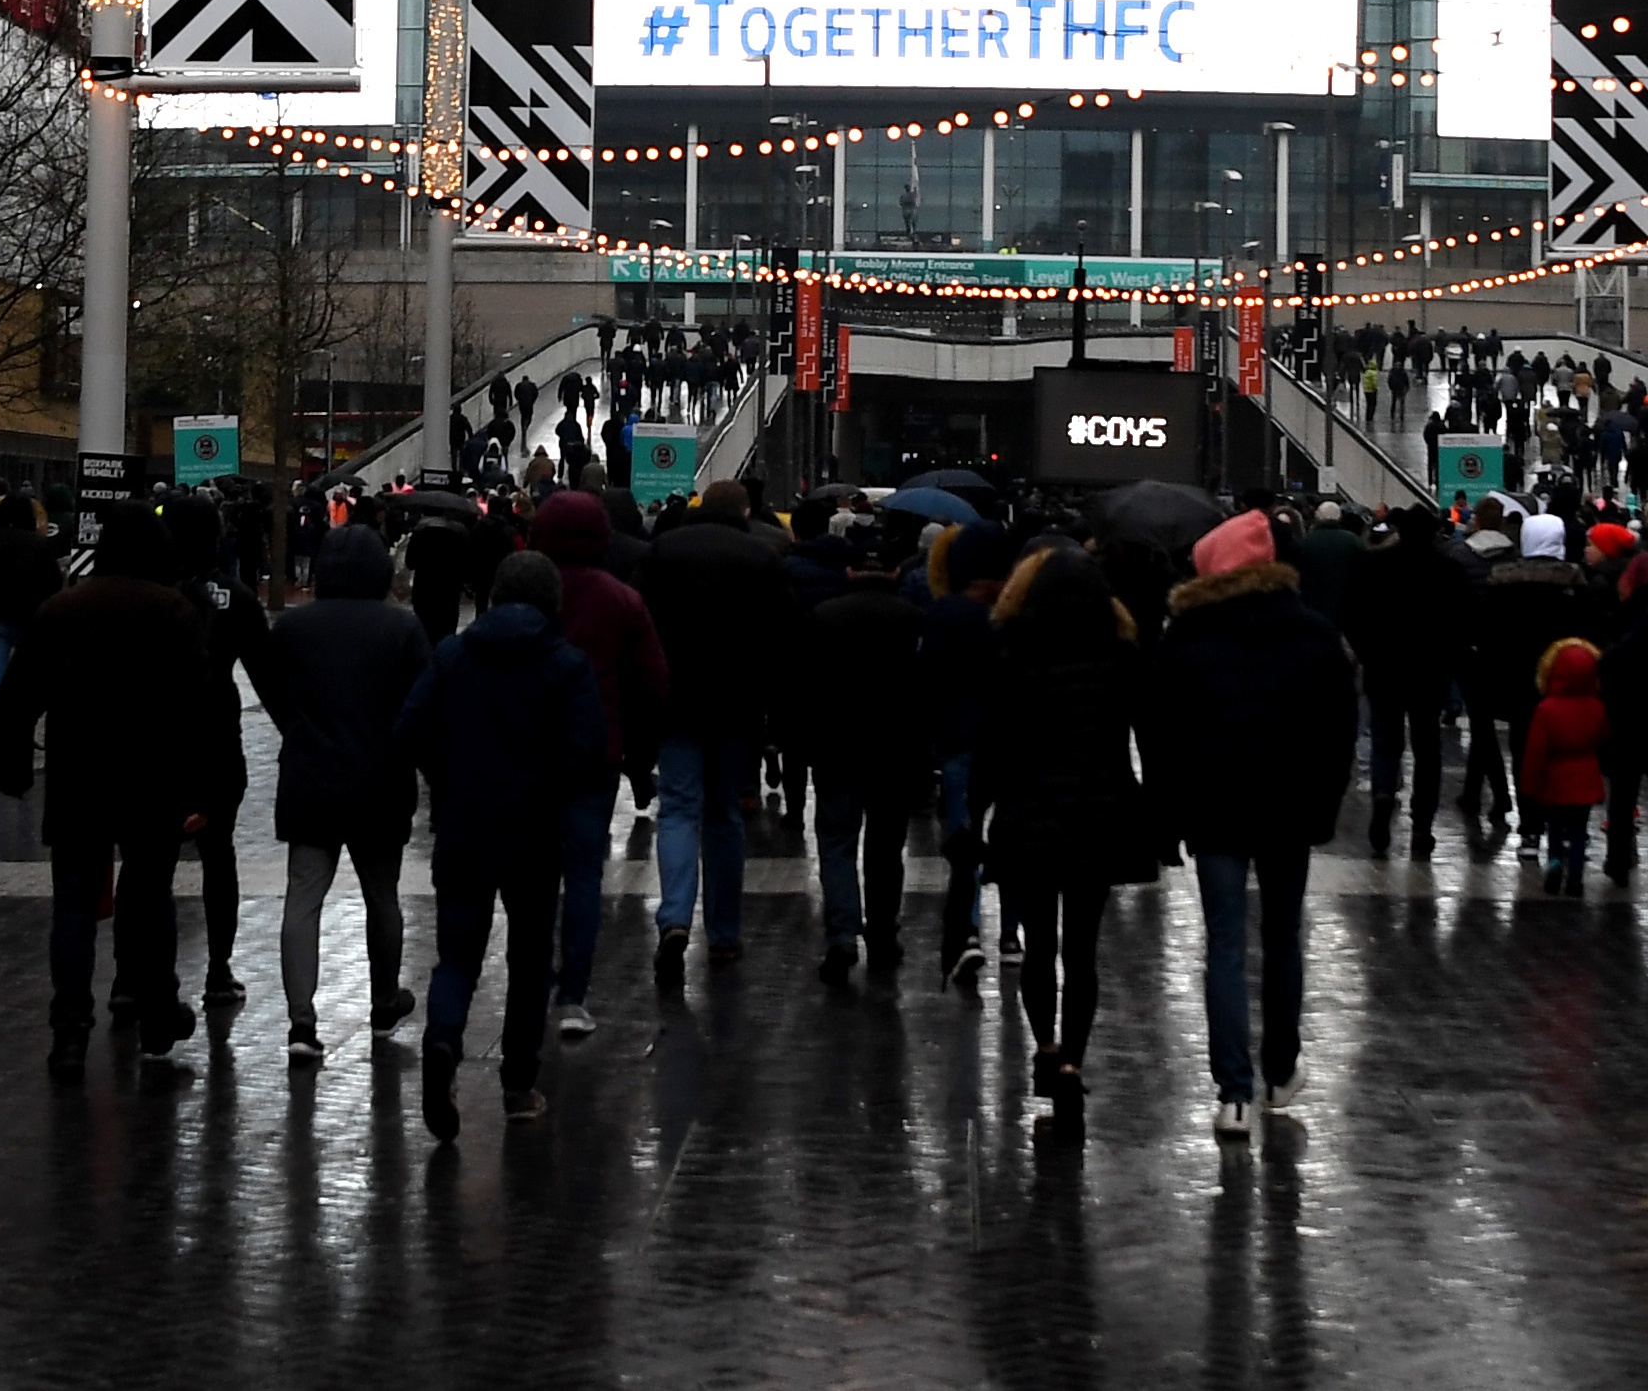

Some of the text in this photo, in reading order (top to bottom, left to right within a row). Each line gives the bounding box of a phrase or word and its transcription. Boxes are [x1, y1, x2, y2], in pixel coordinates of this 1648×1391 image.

[855, 259, 975, 271] Bobby Moore Entrance
[1028, 269, 1069, 285] Level
[1085, 271, 1107, 286] wo
[1110, 271, 1150, 287] West
[1067, 414, 1168, 447] #COYS
